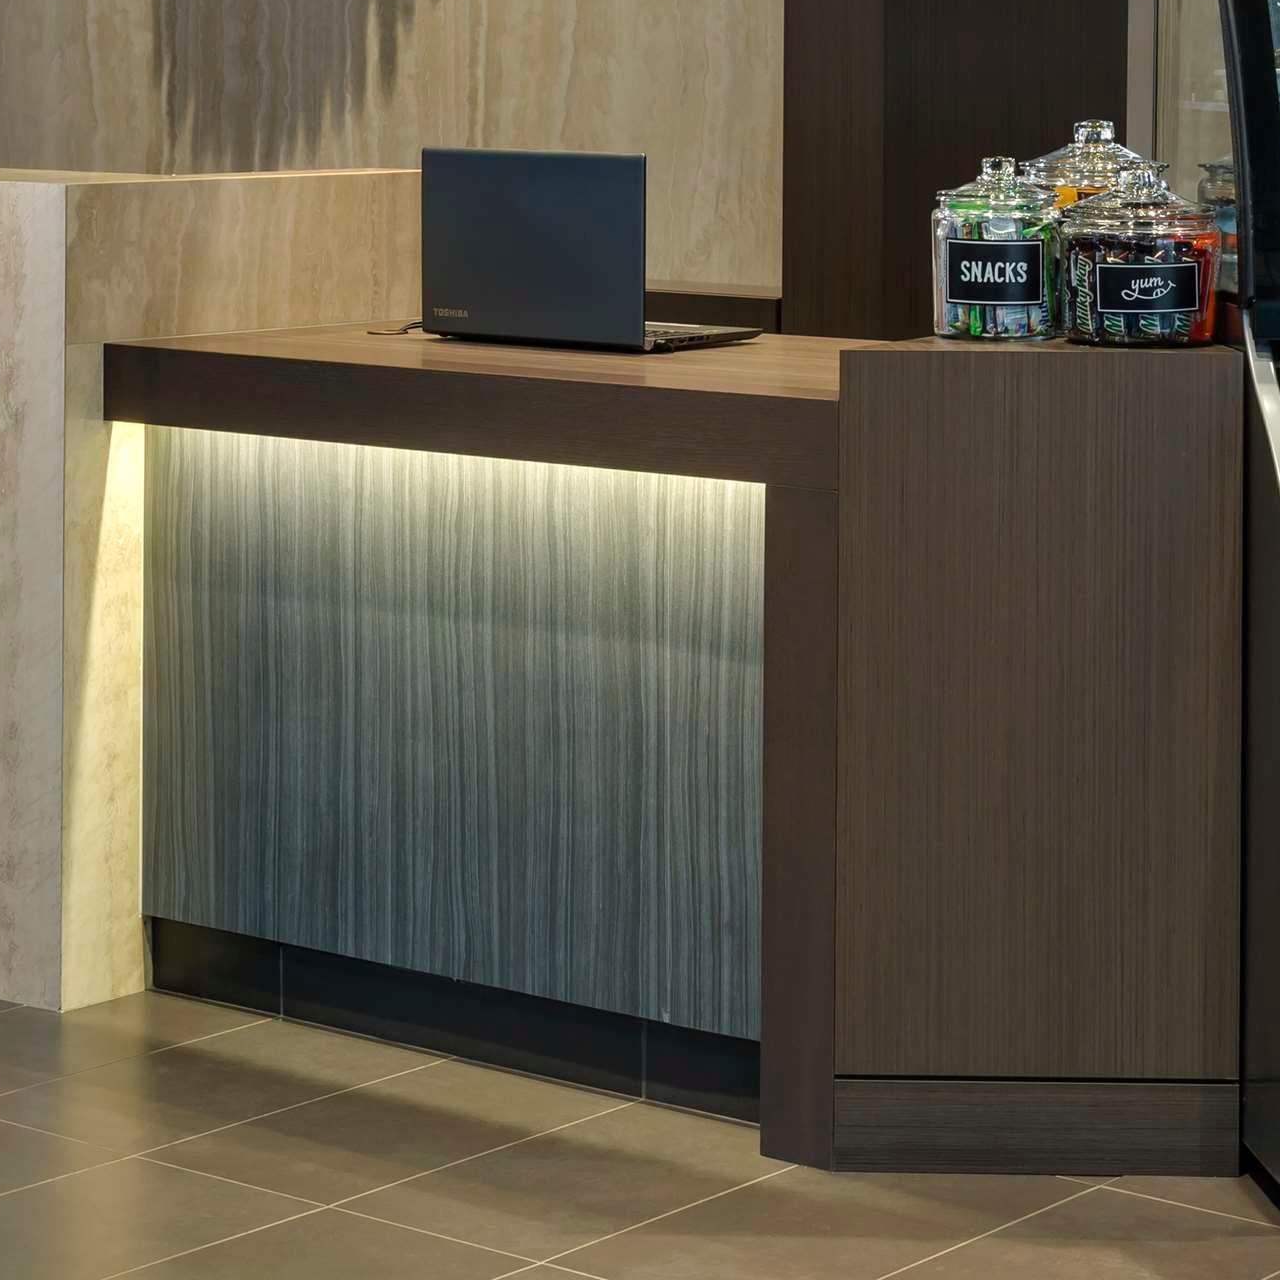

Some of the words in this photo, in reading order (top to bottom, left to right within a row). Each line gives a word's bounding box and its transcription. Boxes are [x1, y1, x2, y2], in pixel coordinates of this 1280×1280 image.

[960, 260, 1028, 283] SNACKS
[1128, 276, 1166, 297] yum
[432, 307, 469, 318] TOSHIBA
